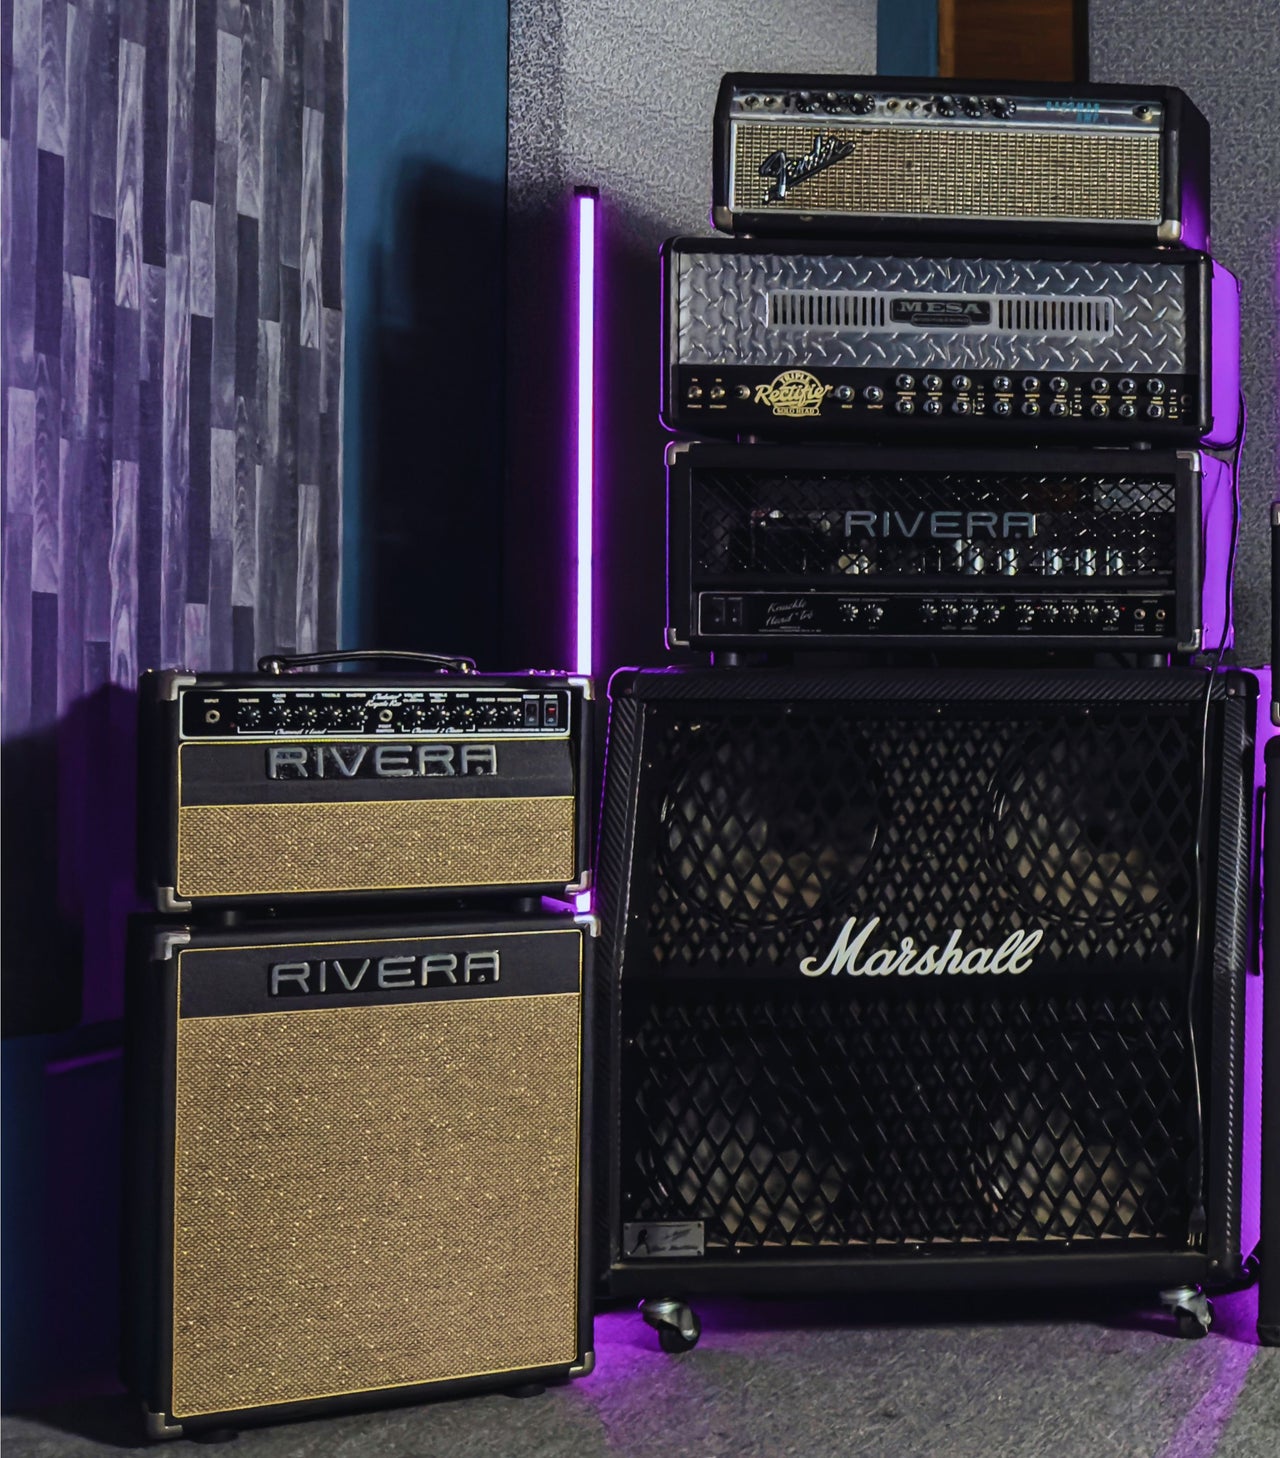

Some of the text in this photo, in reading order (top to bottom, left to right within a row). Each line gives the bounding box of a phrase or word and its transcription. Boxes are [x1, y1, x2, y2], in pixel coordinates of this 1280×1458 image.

[897, 301, 982, 314] MESA
[754, 384, 834, 407] Rectifier
[845, 510, 1035, 538] RIVERA
[268, 744, 498, 780] RIVERA
[799, 916, 1044, 977] Marshall
[271, 950, 500, 996] RIVERA
